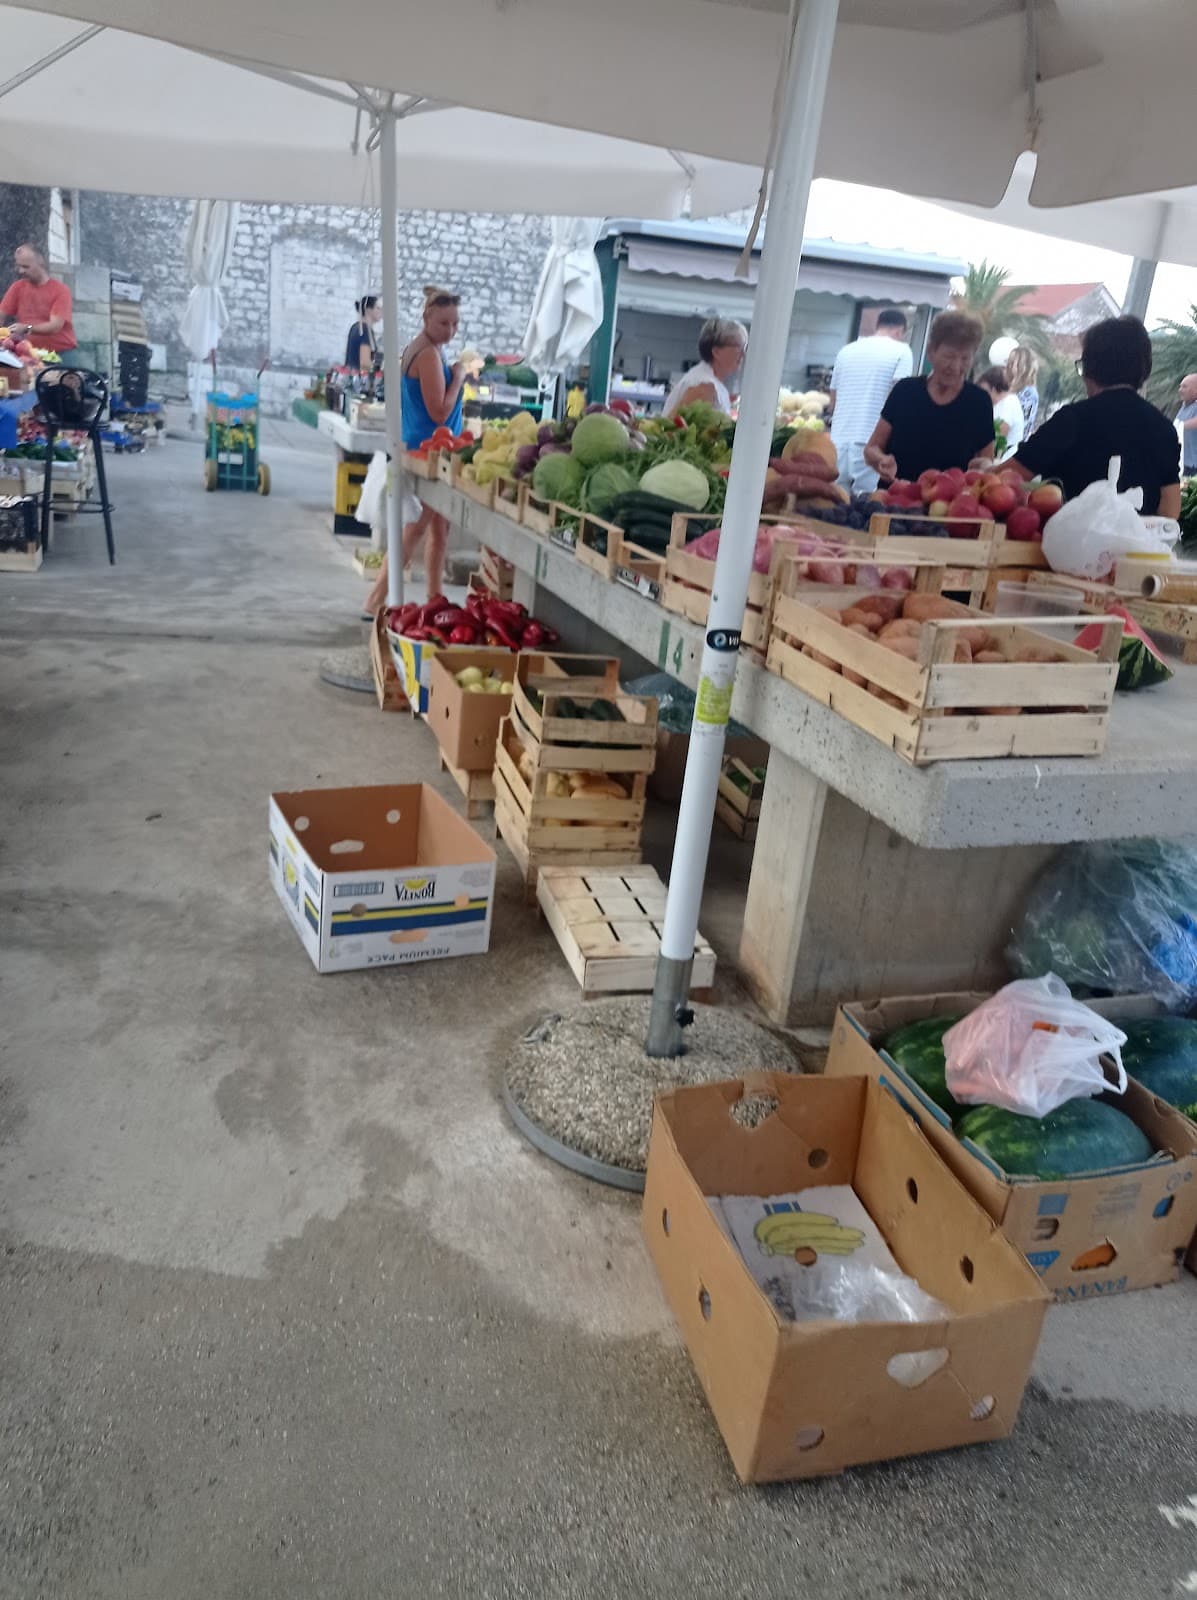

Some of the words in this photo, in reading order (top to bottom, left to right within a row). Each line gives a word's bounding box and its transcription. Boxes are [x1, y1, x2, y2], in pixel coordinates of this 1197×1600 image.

[394, 880, 436, 902] BONITA
[366, 953, 395, 963] PACK
[399, 947, 450, 960] PREMIUM
